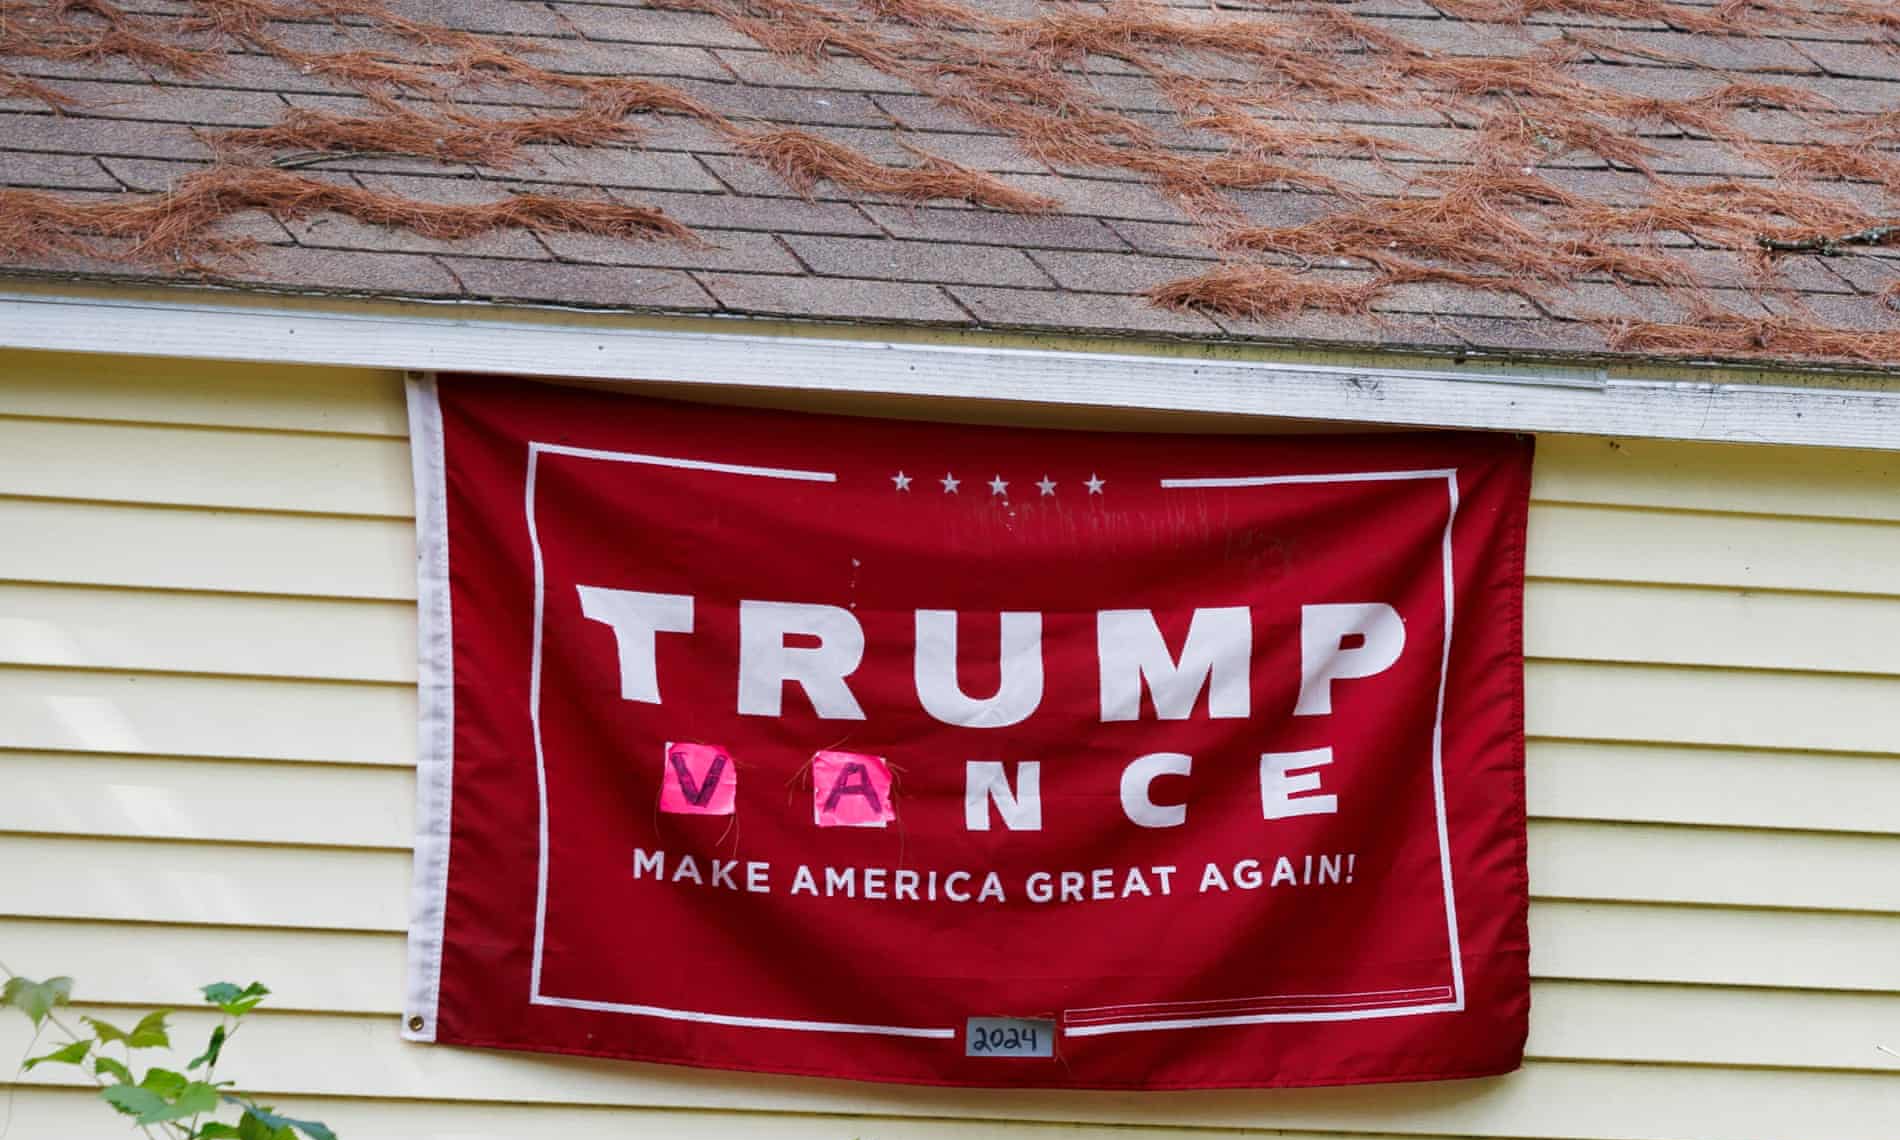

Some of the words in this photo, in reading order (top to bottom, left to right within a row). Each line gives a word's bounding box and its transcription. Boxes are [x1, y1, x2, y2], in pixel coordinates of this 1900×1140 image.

[576, 585, 1405, 728] TRUMP
[670, 745, 1339, 832] VANCE
[632, 847, 771, 894] MAKE
[790, 864, 1006, 903] AMERICA
[1026, 865, 1178, 903] GREAT
[1199, 854, 1357, 894] AGAIN!
[973, 1026, 1038, 1053] 2024
